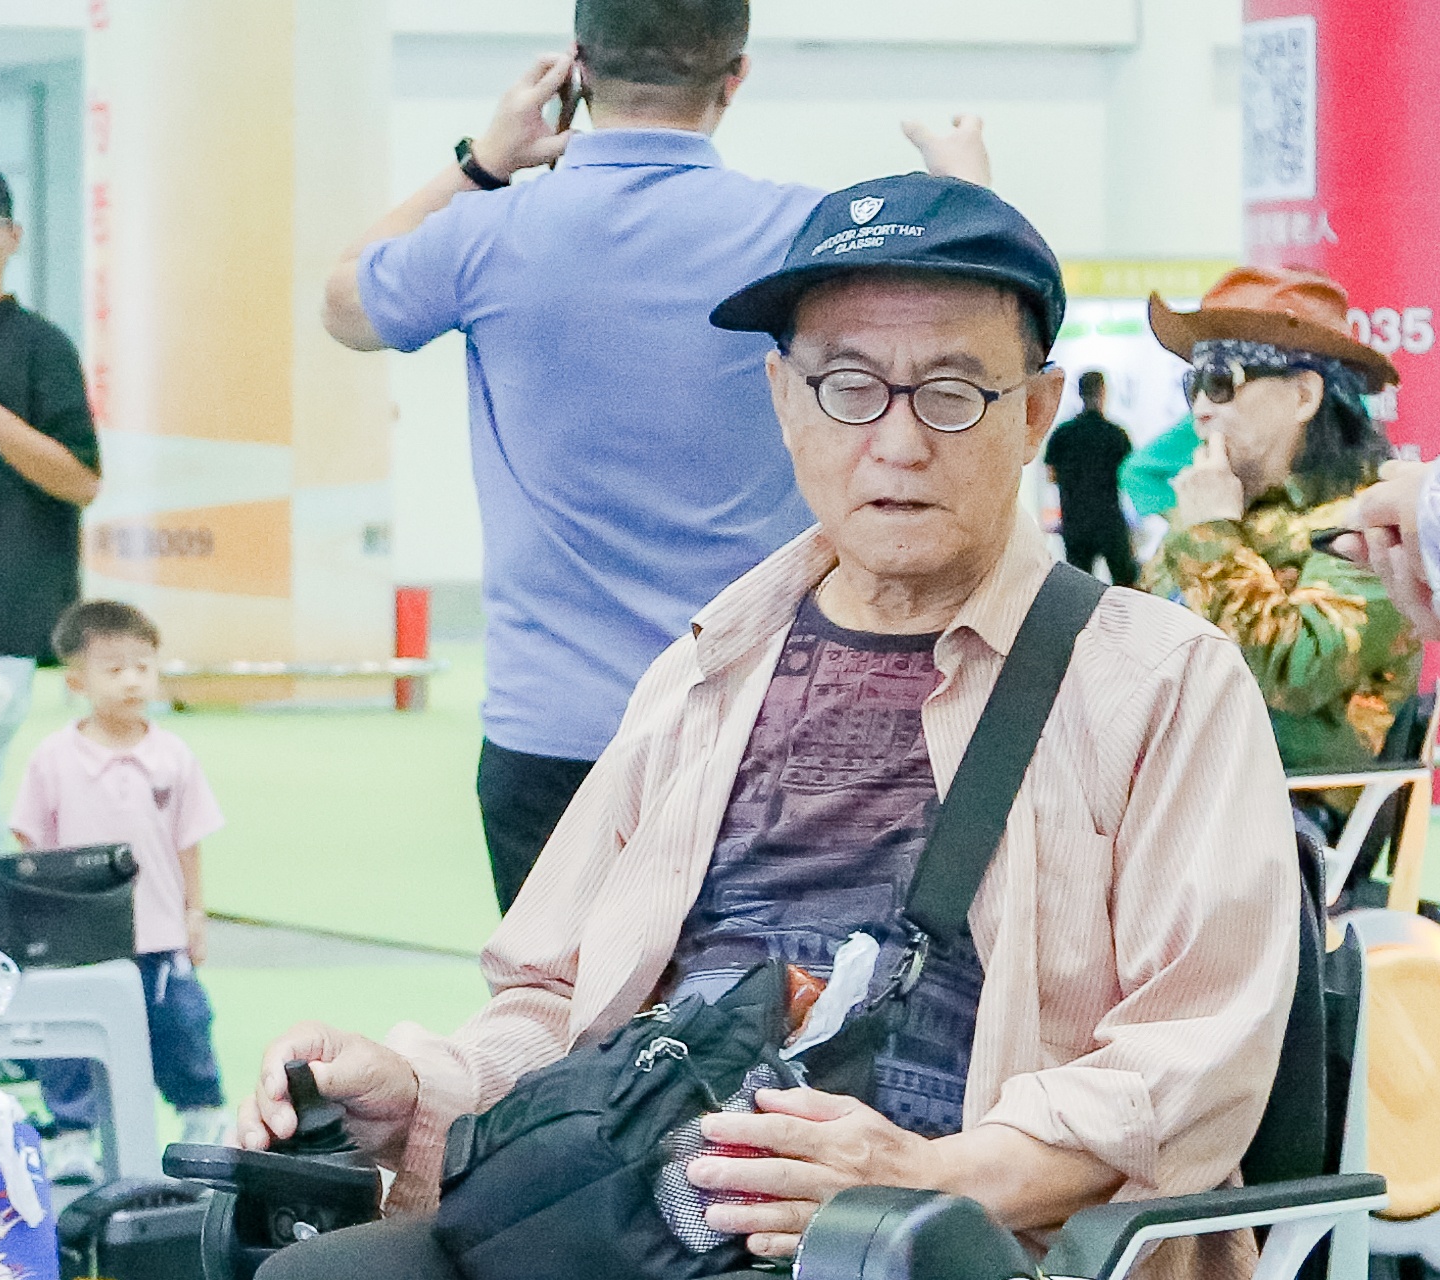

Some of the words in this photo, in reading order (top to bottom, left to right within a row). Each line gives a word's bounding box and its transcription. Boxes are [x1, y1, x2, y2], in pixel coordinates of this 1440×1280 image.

[856, 223, 899, 238] SPORT
[897, 223, 926, 238] HAT
[834, 236, 886, 256] CLASSIC
